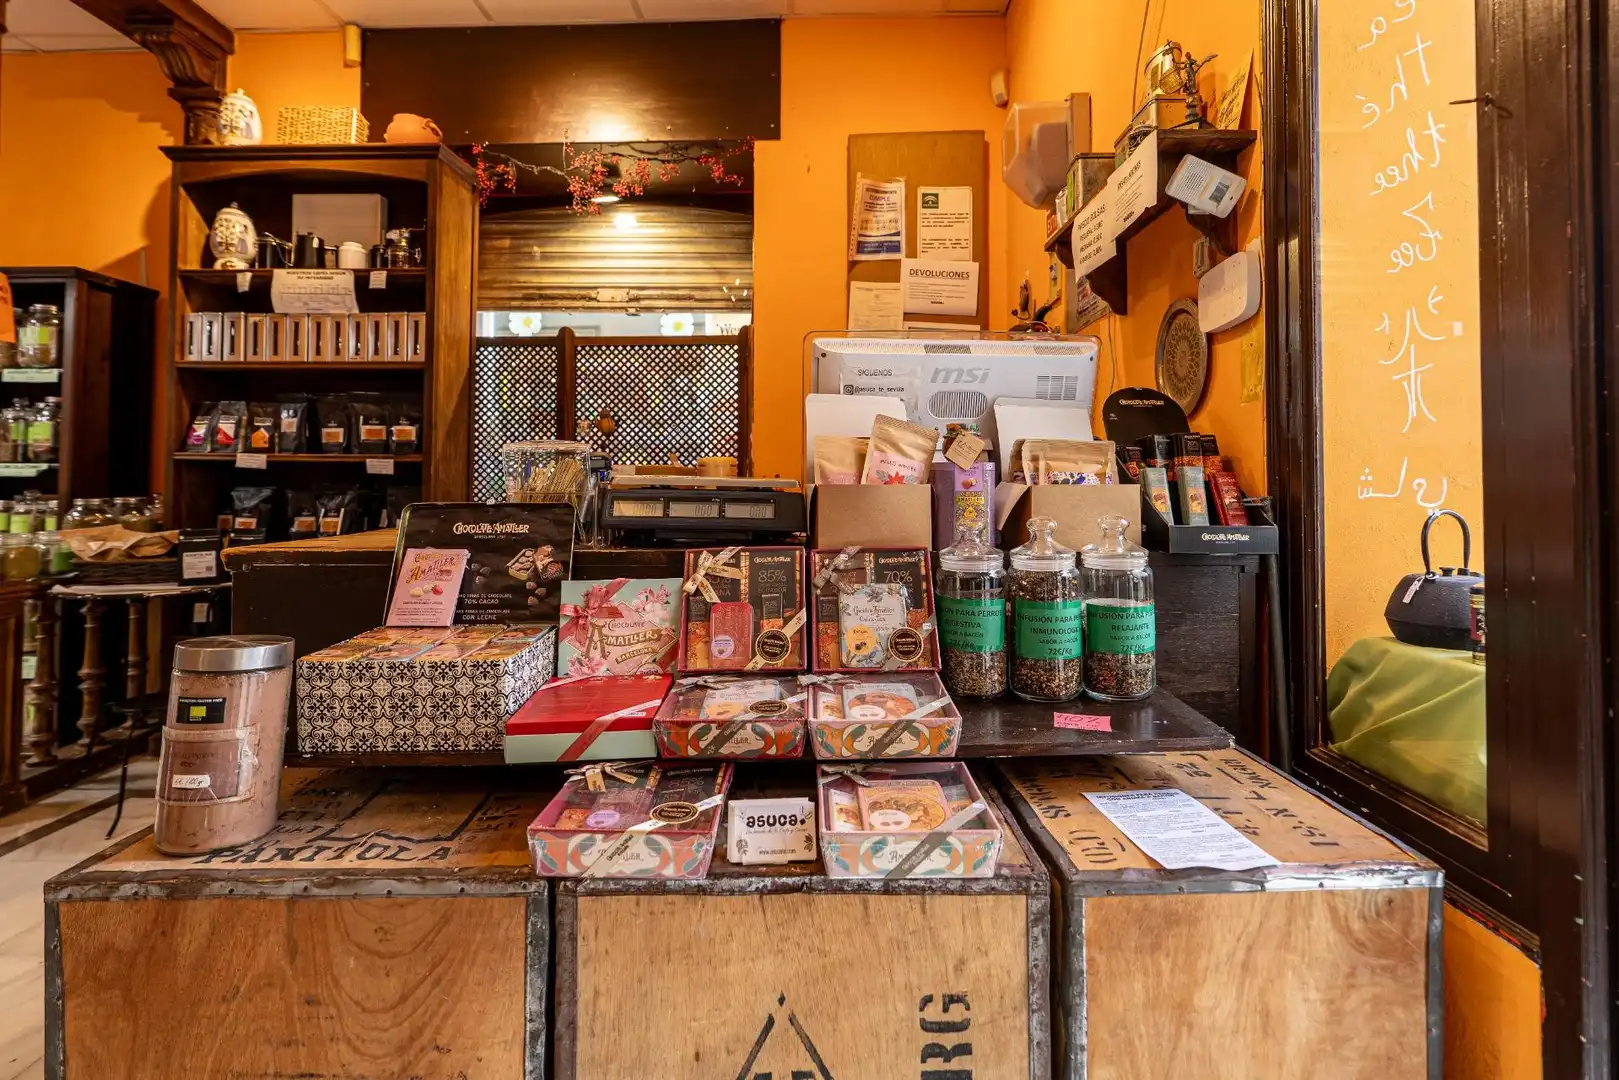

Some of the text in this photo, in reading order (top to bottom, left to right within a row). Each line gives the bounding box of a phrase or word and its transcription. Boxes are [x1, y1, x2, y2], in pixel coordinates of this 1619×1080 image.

[909, 268, 970, 279] DEVOLUCIONES
[930, 366, 991, 384] msi
[758, 569, 787, 583] 85%
[883, 570, 913, 583] 70%
[955, 609, 976, 617] PARA
[1054, 615, 1073, 623] PARA
[1111, 622, 1150, 632] RELAJANTE
[1047, 647, 1073, 656] 72€/Kg
[192, 842, 453, 864] PANITOLA
